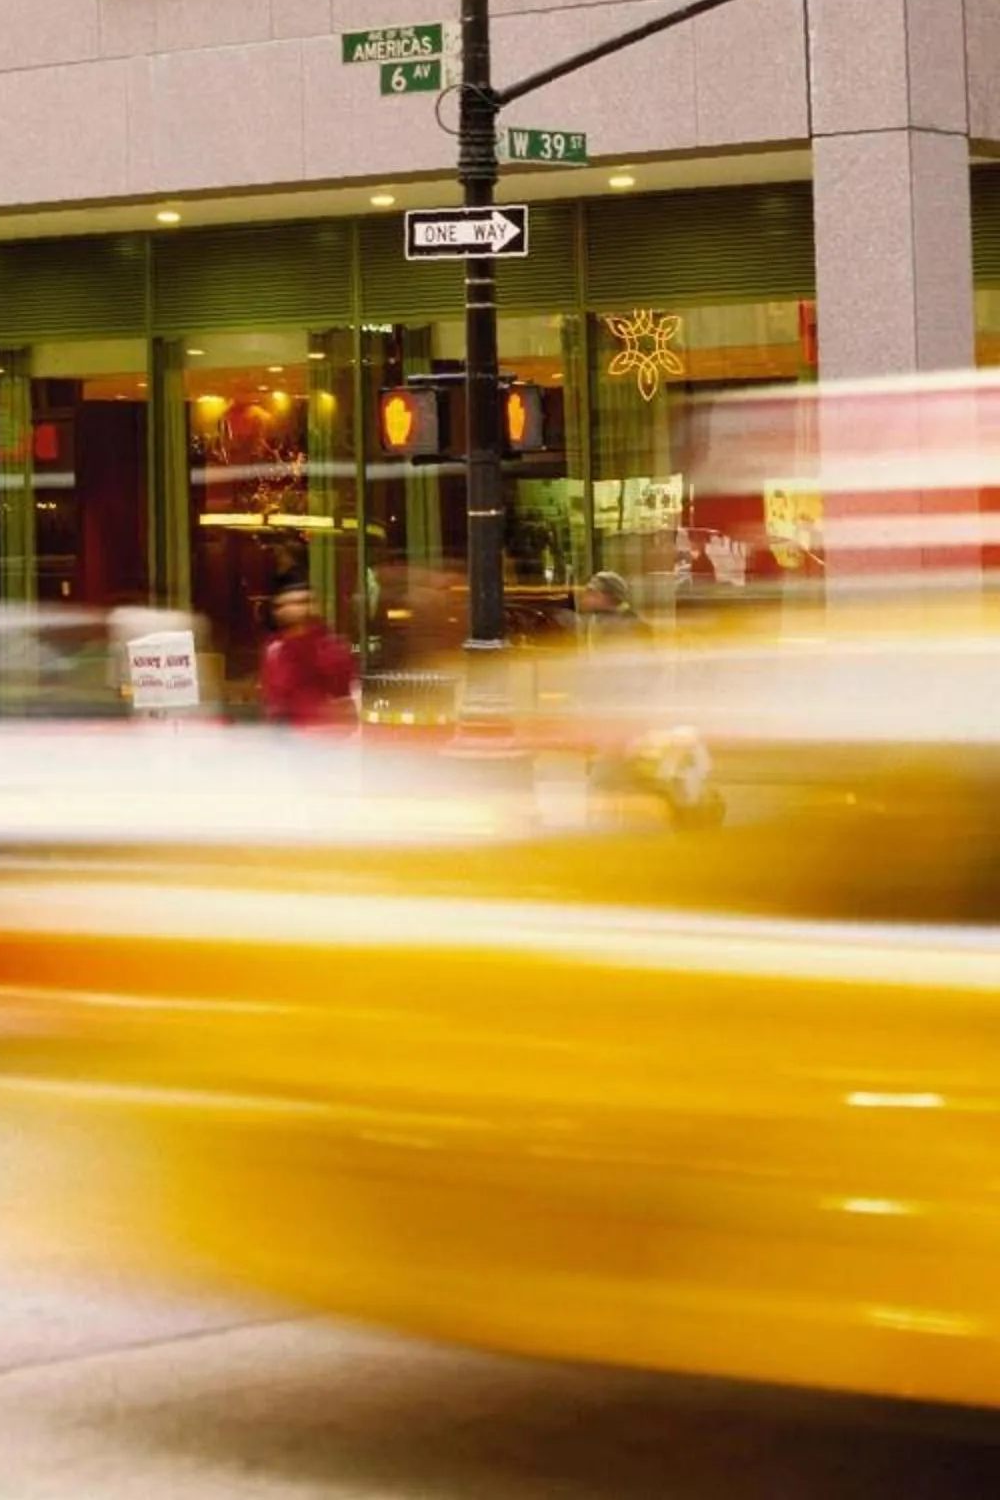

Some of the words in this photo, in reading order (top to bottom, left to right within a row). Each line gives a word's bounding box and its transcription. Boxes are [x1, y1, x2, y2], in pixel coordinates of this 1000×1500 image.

[353, 36, 432, 61] AMERICAS
[391, 66, 407, 92] 6
[412, 63, 431, 79] AV
[513, 131, 529, 157] W
[540, 133, 565, 159] 39
[424, 225, 457, 243] ONE
[473, 223, 507, 242] WAY
